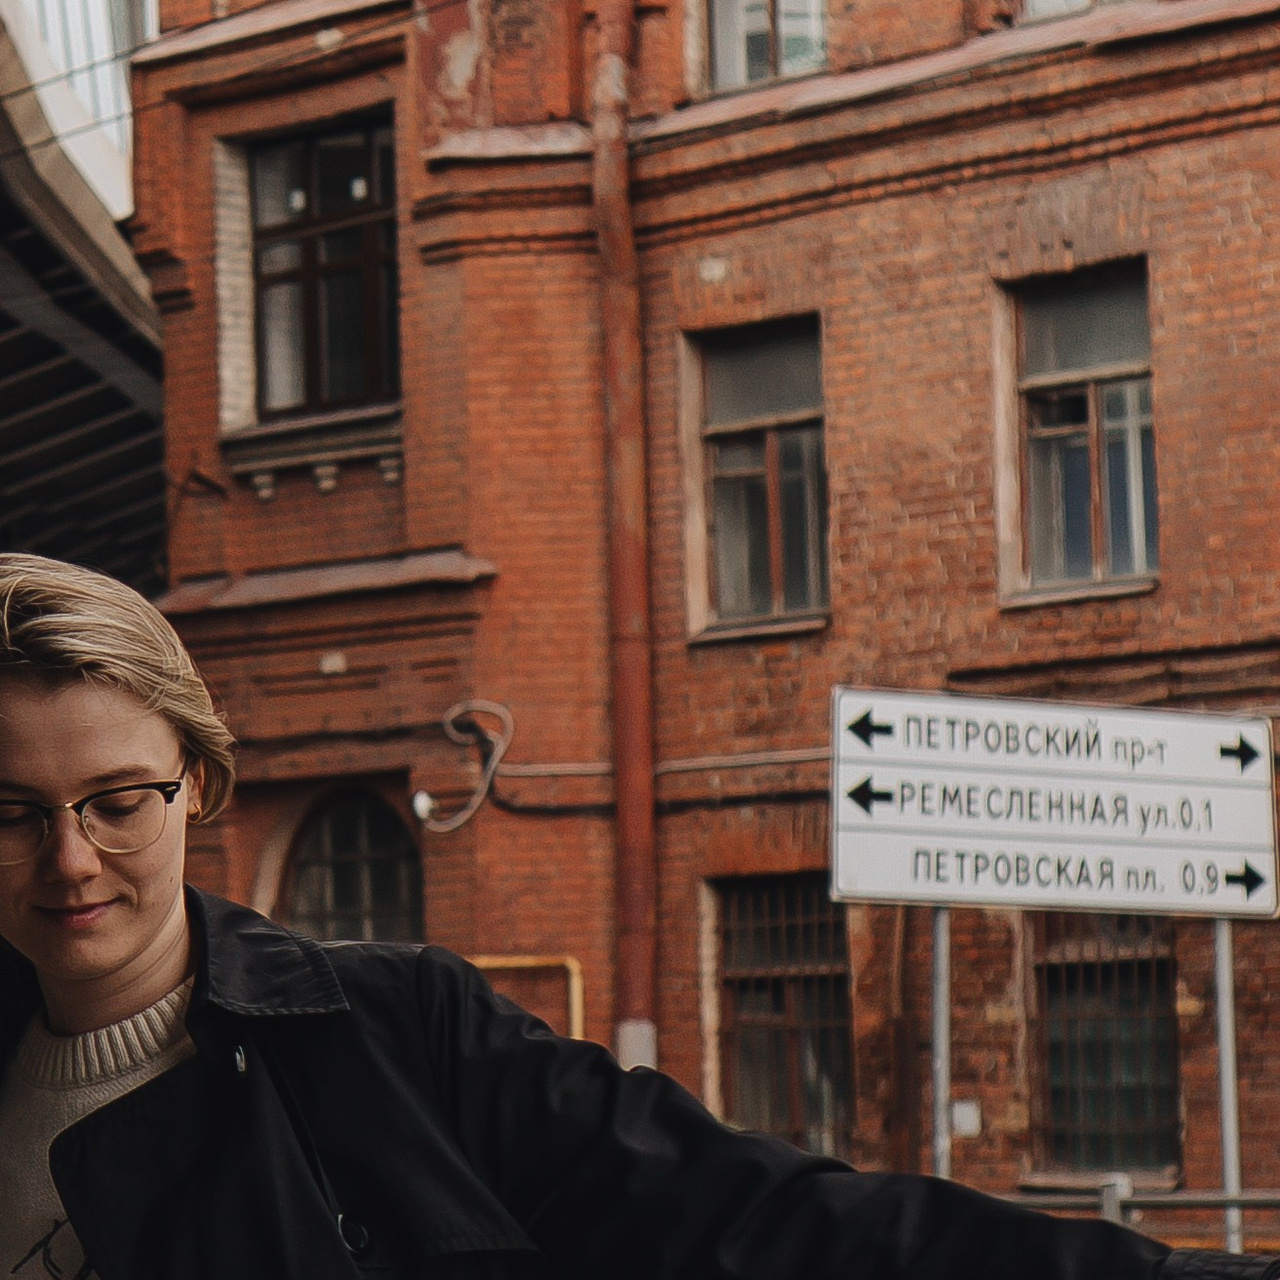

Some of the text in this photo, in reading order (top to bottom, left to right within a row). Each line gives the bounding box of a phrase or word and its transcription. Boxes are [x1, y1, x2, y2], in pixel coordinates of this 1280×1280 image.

[905, 715, 1167, 771] ПЕТРОВСКИЙ пр-т
[900, 782, 1128, 826] РЕМЕСЛЕННАЯ
[913, 850, 1115, 891] ПЕТРОВСКАЯ
[1126, 868, 1165, 893] пл.
